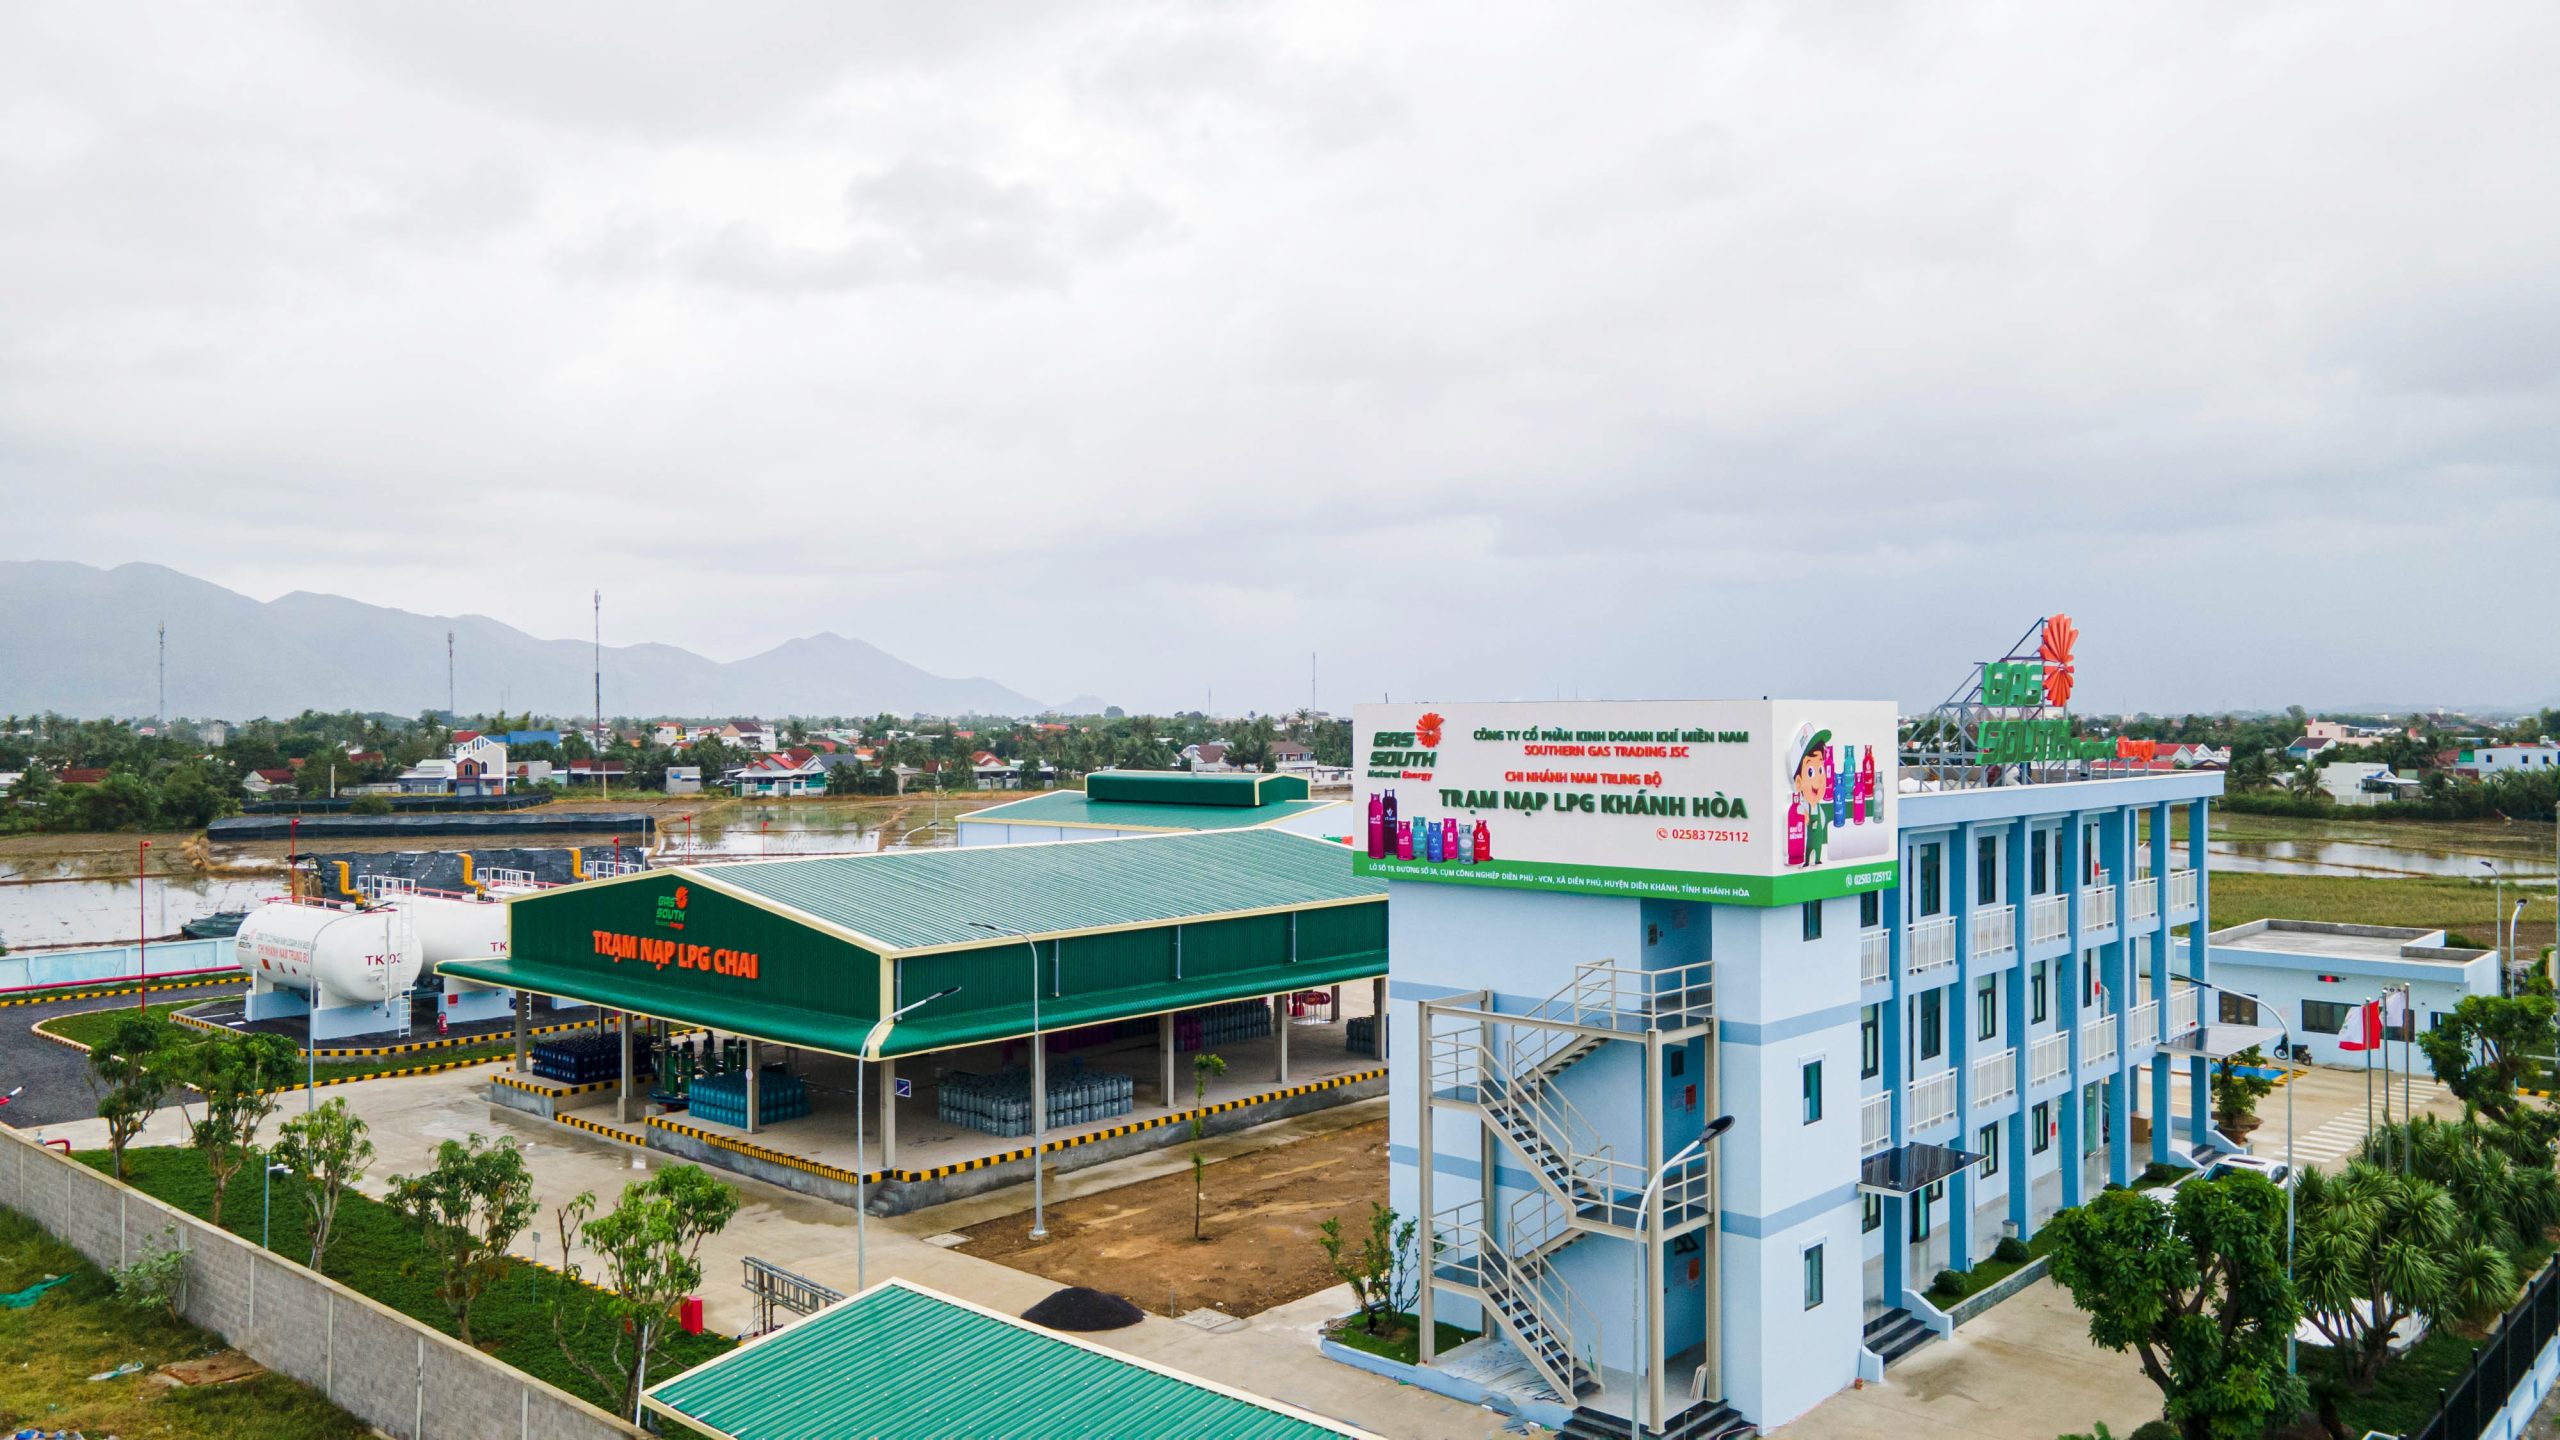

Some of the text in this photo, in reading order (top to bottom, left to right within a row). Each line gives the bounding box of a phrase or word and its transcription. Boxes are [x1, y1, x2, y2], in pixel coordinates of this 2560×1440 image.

[1981, 661, 2043, 706] GAS
[1373, 731, 1415, 748] GAS
[1473, 727, 1504, 741] CÔNG
[1506, 730, 1520, 741] TY
[1542, 727, 1573, 742] PHẦN
[1576, 731, 1606, 742] KINH
[1608, 731, 1653, 742] DOANH
[1656, 728, 1679, 742] KHÍ
[1682, 727, 1714, 743] MIỀN
[1718, 731, 1749, 743] NAM
[1975, 719, 2072, 765] SOUTH
[1369, 751, 1438, 767] SOUTH
[1524, 745, 1690, 758] SOUTHERN GAS TRADING JSC
[1367, 770, 1433, 781] Natural Energy
[1505, 769, 1662, 788] CHI NHÁNH NAM TRUNG BỘ
[1439, 788, 1749, 819] TRẠM NẠP LPG KHÁNH HÒA
[1672, 829, 1749, 842] 02583 725112
[1440, 869, 1454, 877] CỤM
[1455, 869, 1474, 878] CÔNG
[1604, 879, 1629, 890] HUYỆN
[1650, 881, 1680, 893] KHÁNH,
[1702, 885, 1731, 896] KHÁNH
[1732, 886, 1750, 897] HÒA
[657, 895, 675, 907] GAS
[655, 907, 685, 922] SOUTH
[592, 930, 758, 979] TRẠM NẠP LPG CHAI
